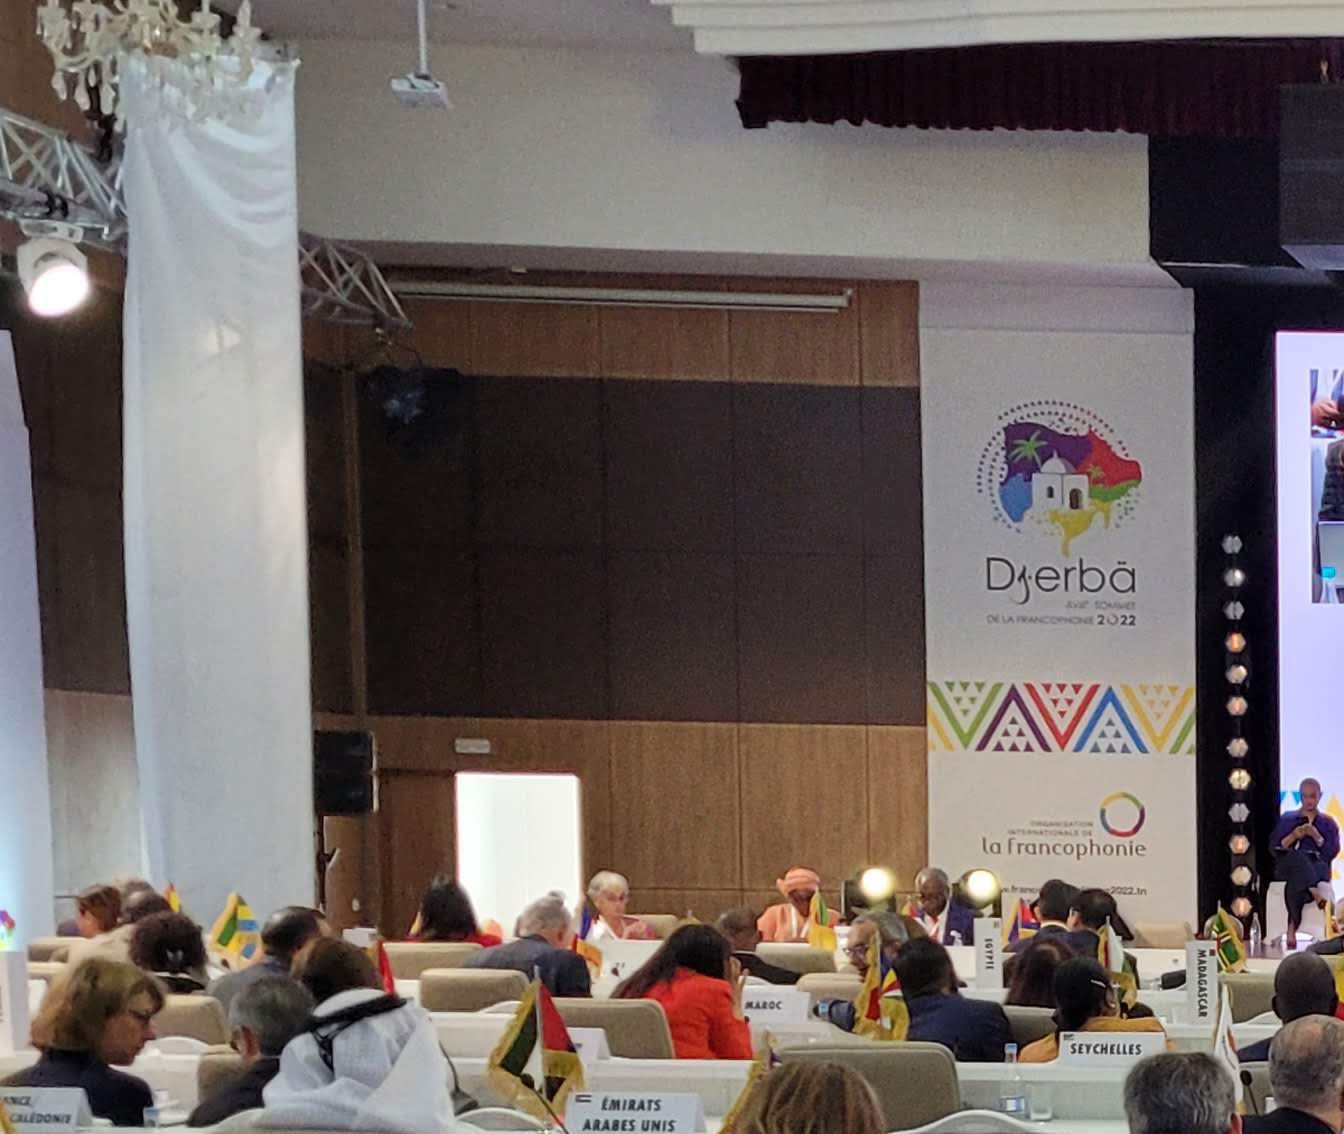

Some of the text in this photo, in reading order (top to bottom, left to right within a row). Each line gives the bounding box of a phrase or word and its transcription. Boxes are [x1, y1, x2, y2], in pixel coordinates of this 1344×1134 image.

[1017, 615, 1094, 626] FRANCOPHONIE
[1097, 614, 1136, 626] 2022
[982, 837, 1147, 860] la francophonie
[1197, 949, 1208, 1018] MADAGASCAR
[745, 1000, 783, 1010] MAROC
[1070, 1042, 1142, 1056] SEYCHELLES
[601, 1095, 662, 1112] ÉMIRATS
[582, 1118, 676, 1133] ARABES UNIS
